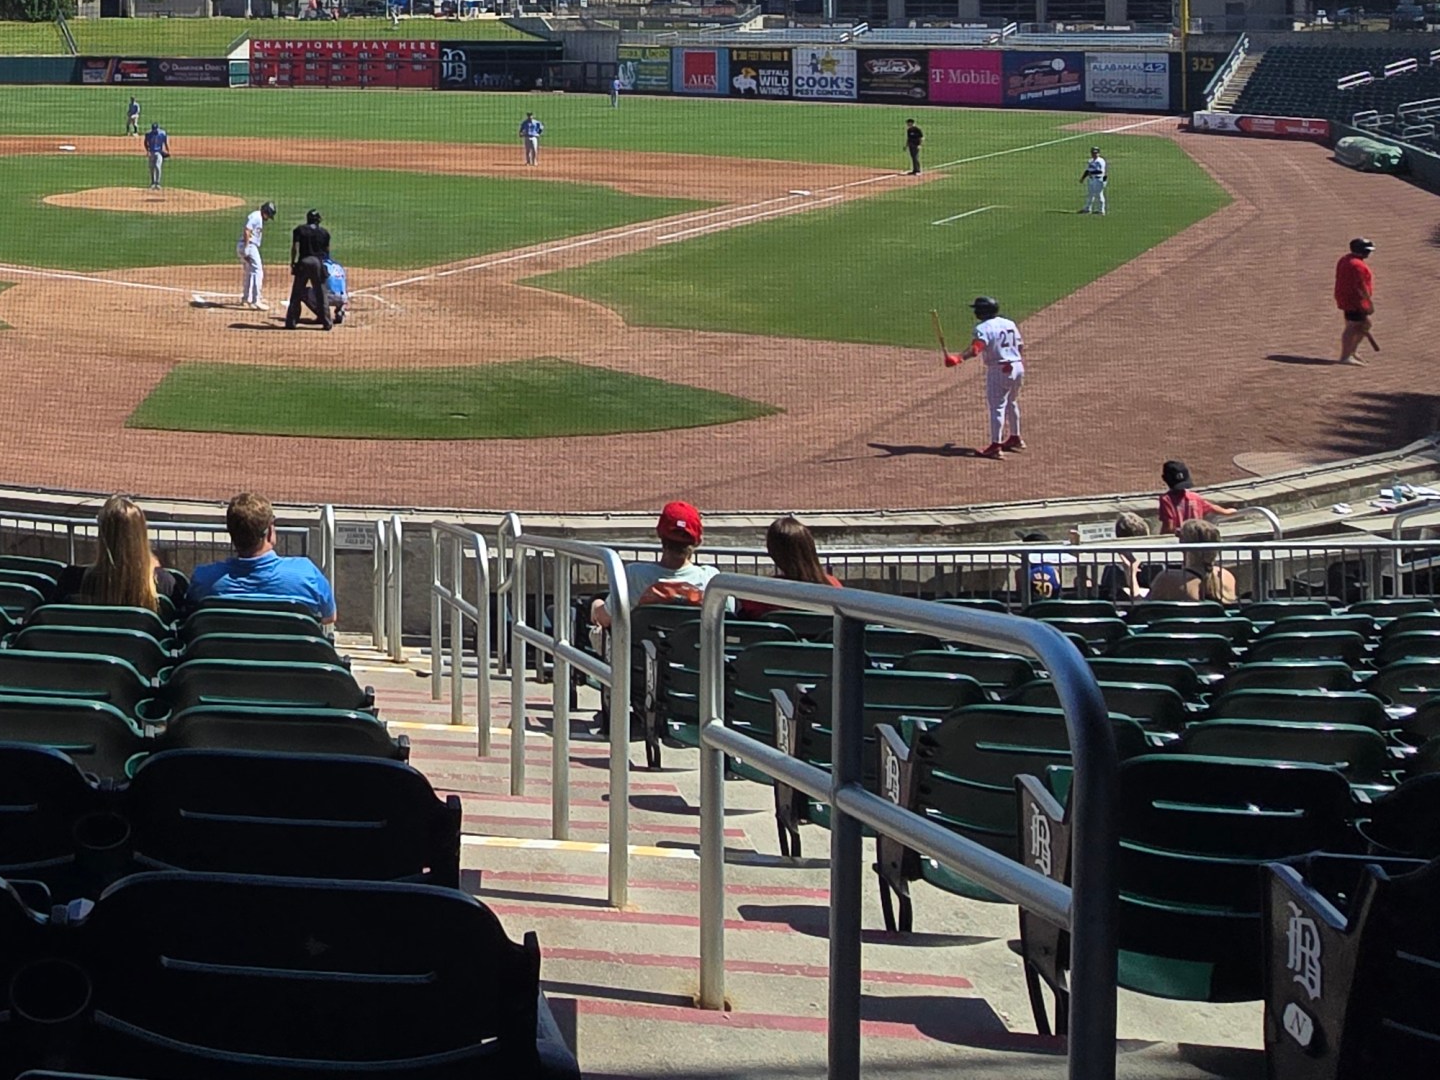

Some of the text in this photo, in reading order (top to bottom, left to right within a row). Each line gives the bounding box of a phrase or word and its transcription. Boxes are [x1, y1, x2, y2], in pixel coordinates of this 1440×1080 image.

[253, 41, 436, 50] CHAMPIONS PLAY HERE
[1191, 56, 1215, 71] 325
[758, 68, 789, 76] BUFFALO
[947, 68, 1000, 85] Mobile
[759, 76, 789, 87] WILD
[795, 76, 855, 89] COOK'S
[1092, 78, 1130, 87] LOCAL
[759, 86, 789, 95] WINGS
[795, 88, 855, 97] PEST CONTROL
[1091, 86, 1164, 95] COVERAGE
[999, 329, 1017, 348] 27
[1290, 1010, 1307, 1037] N
